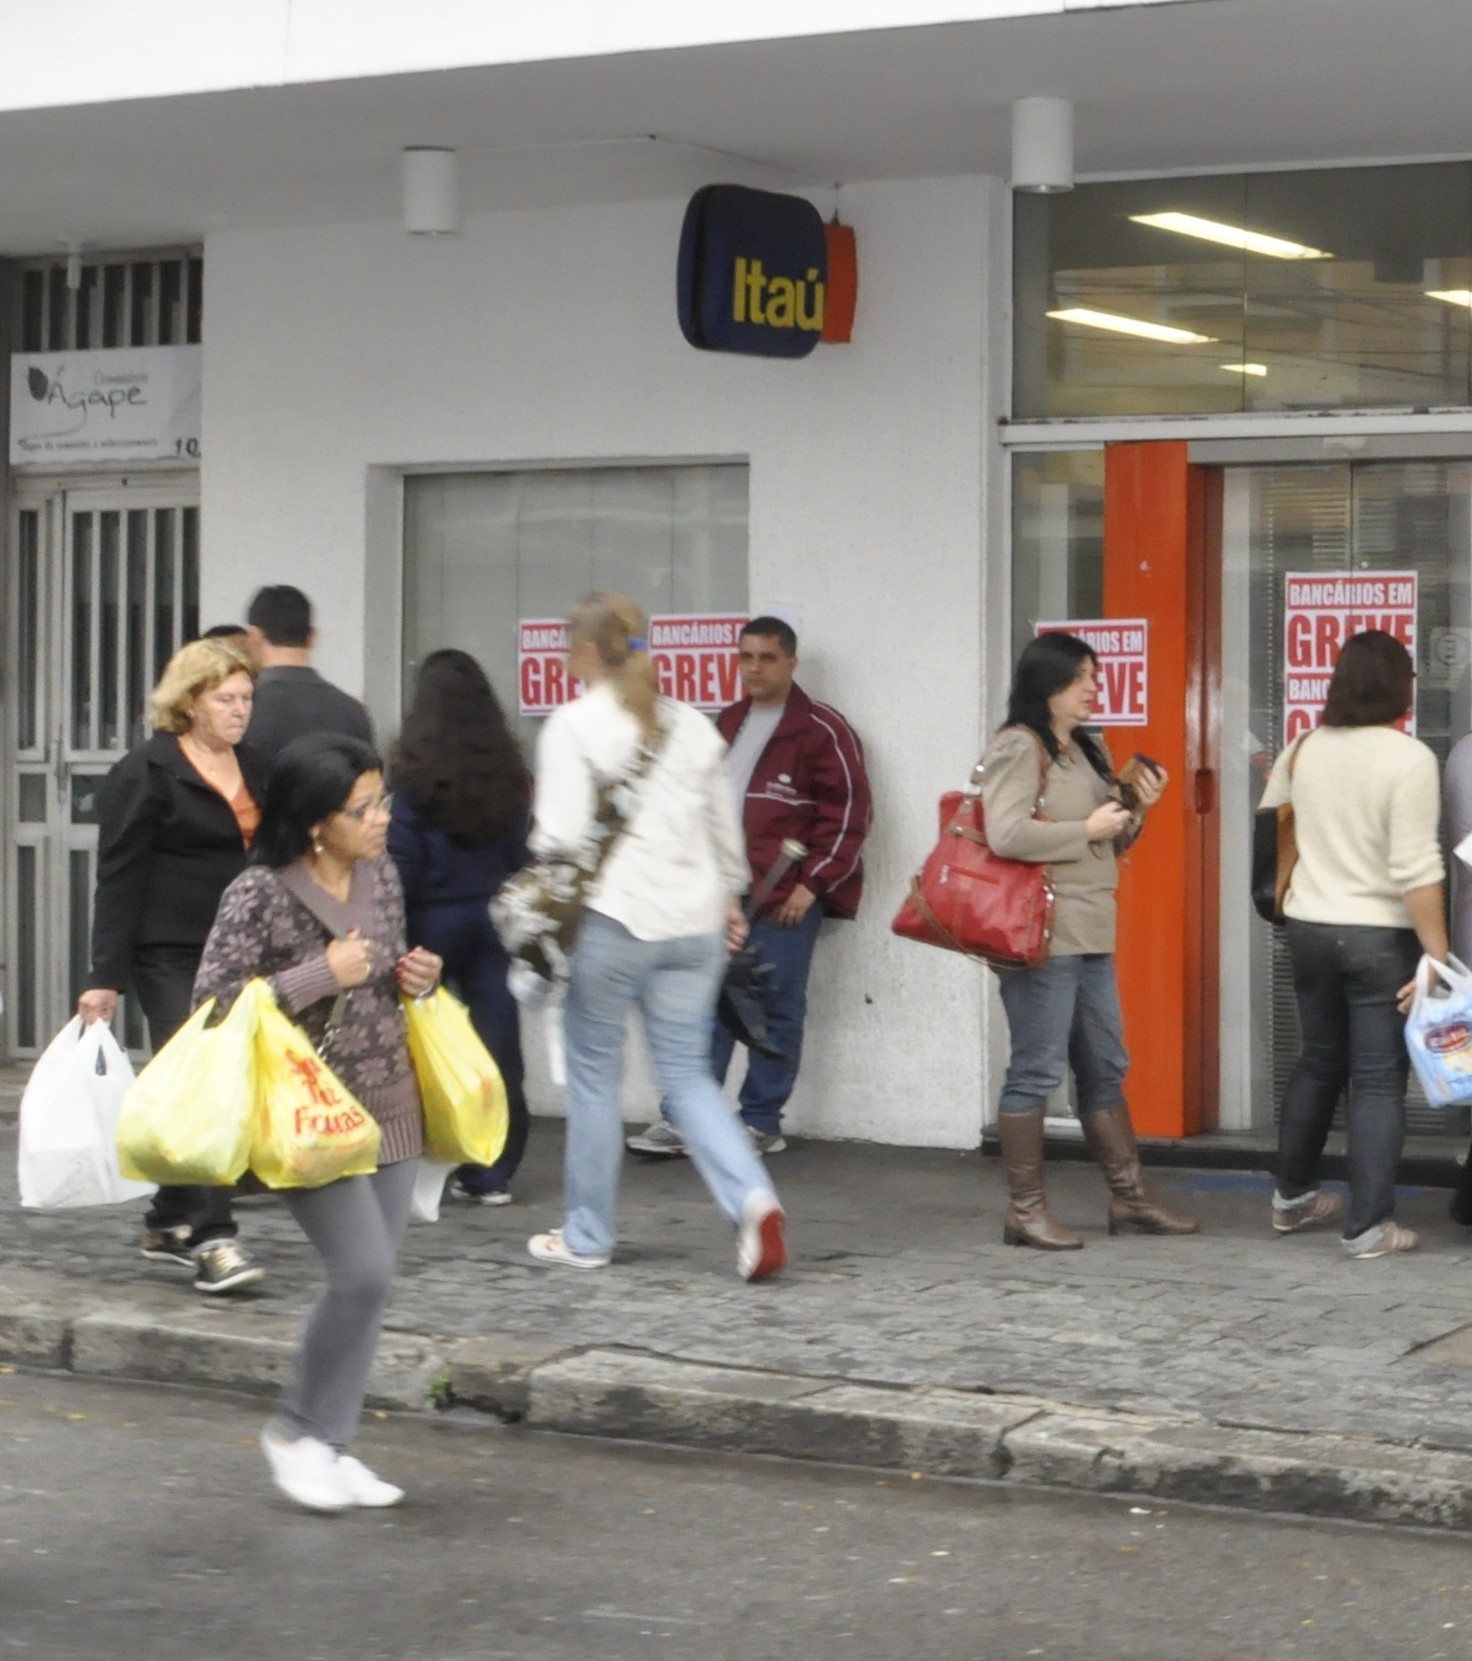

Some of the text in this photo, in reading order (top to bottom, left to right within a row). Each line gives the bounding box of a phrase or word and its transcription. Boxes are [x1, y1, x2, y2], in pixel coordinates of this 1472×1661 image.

[732, 256, 825, 331] Itaú
[1289, 579, 1413, 606] BANCÁRIOS EM
[652, 622, 732, 647] BANCÁRIOS
[1123, 631, 1143, 652] EM
